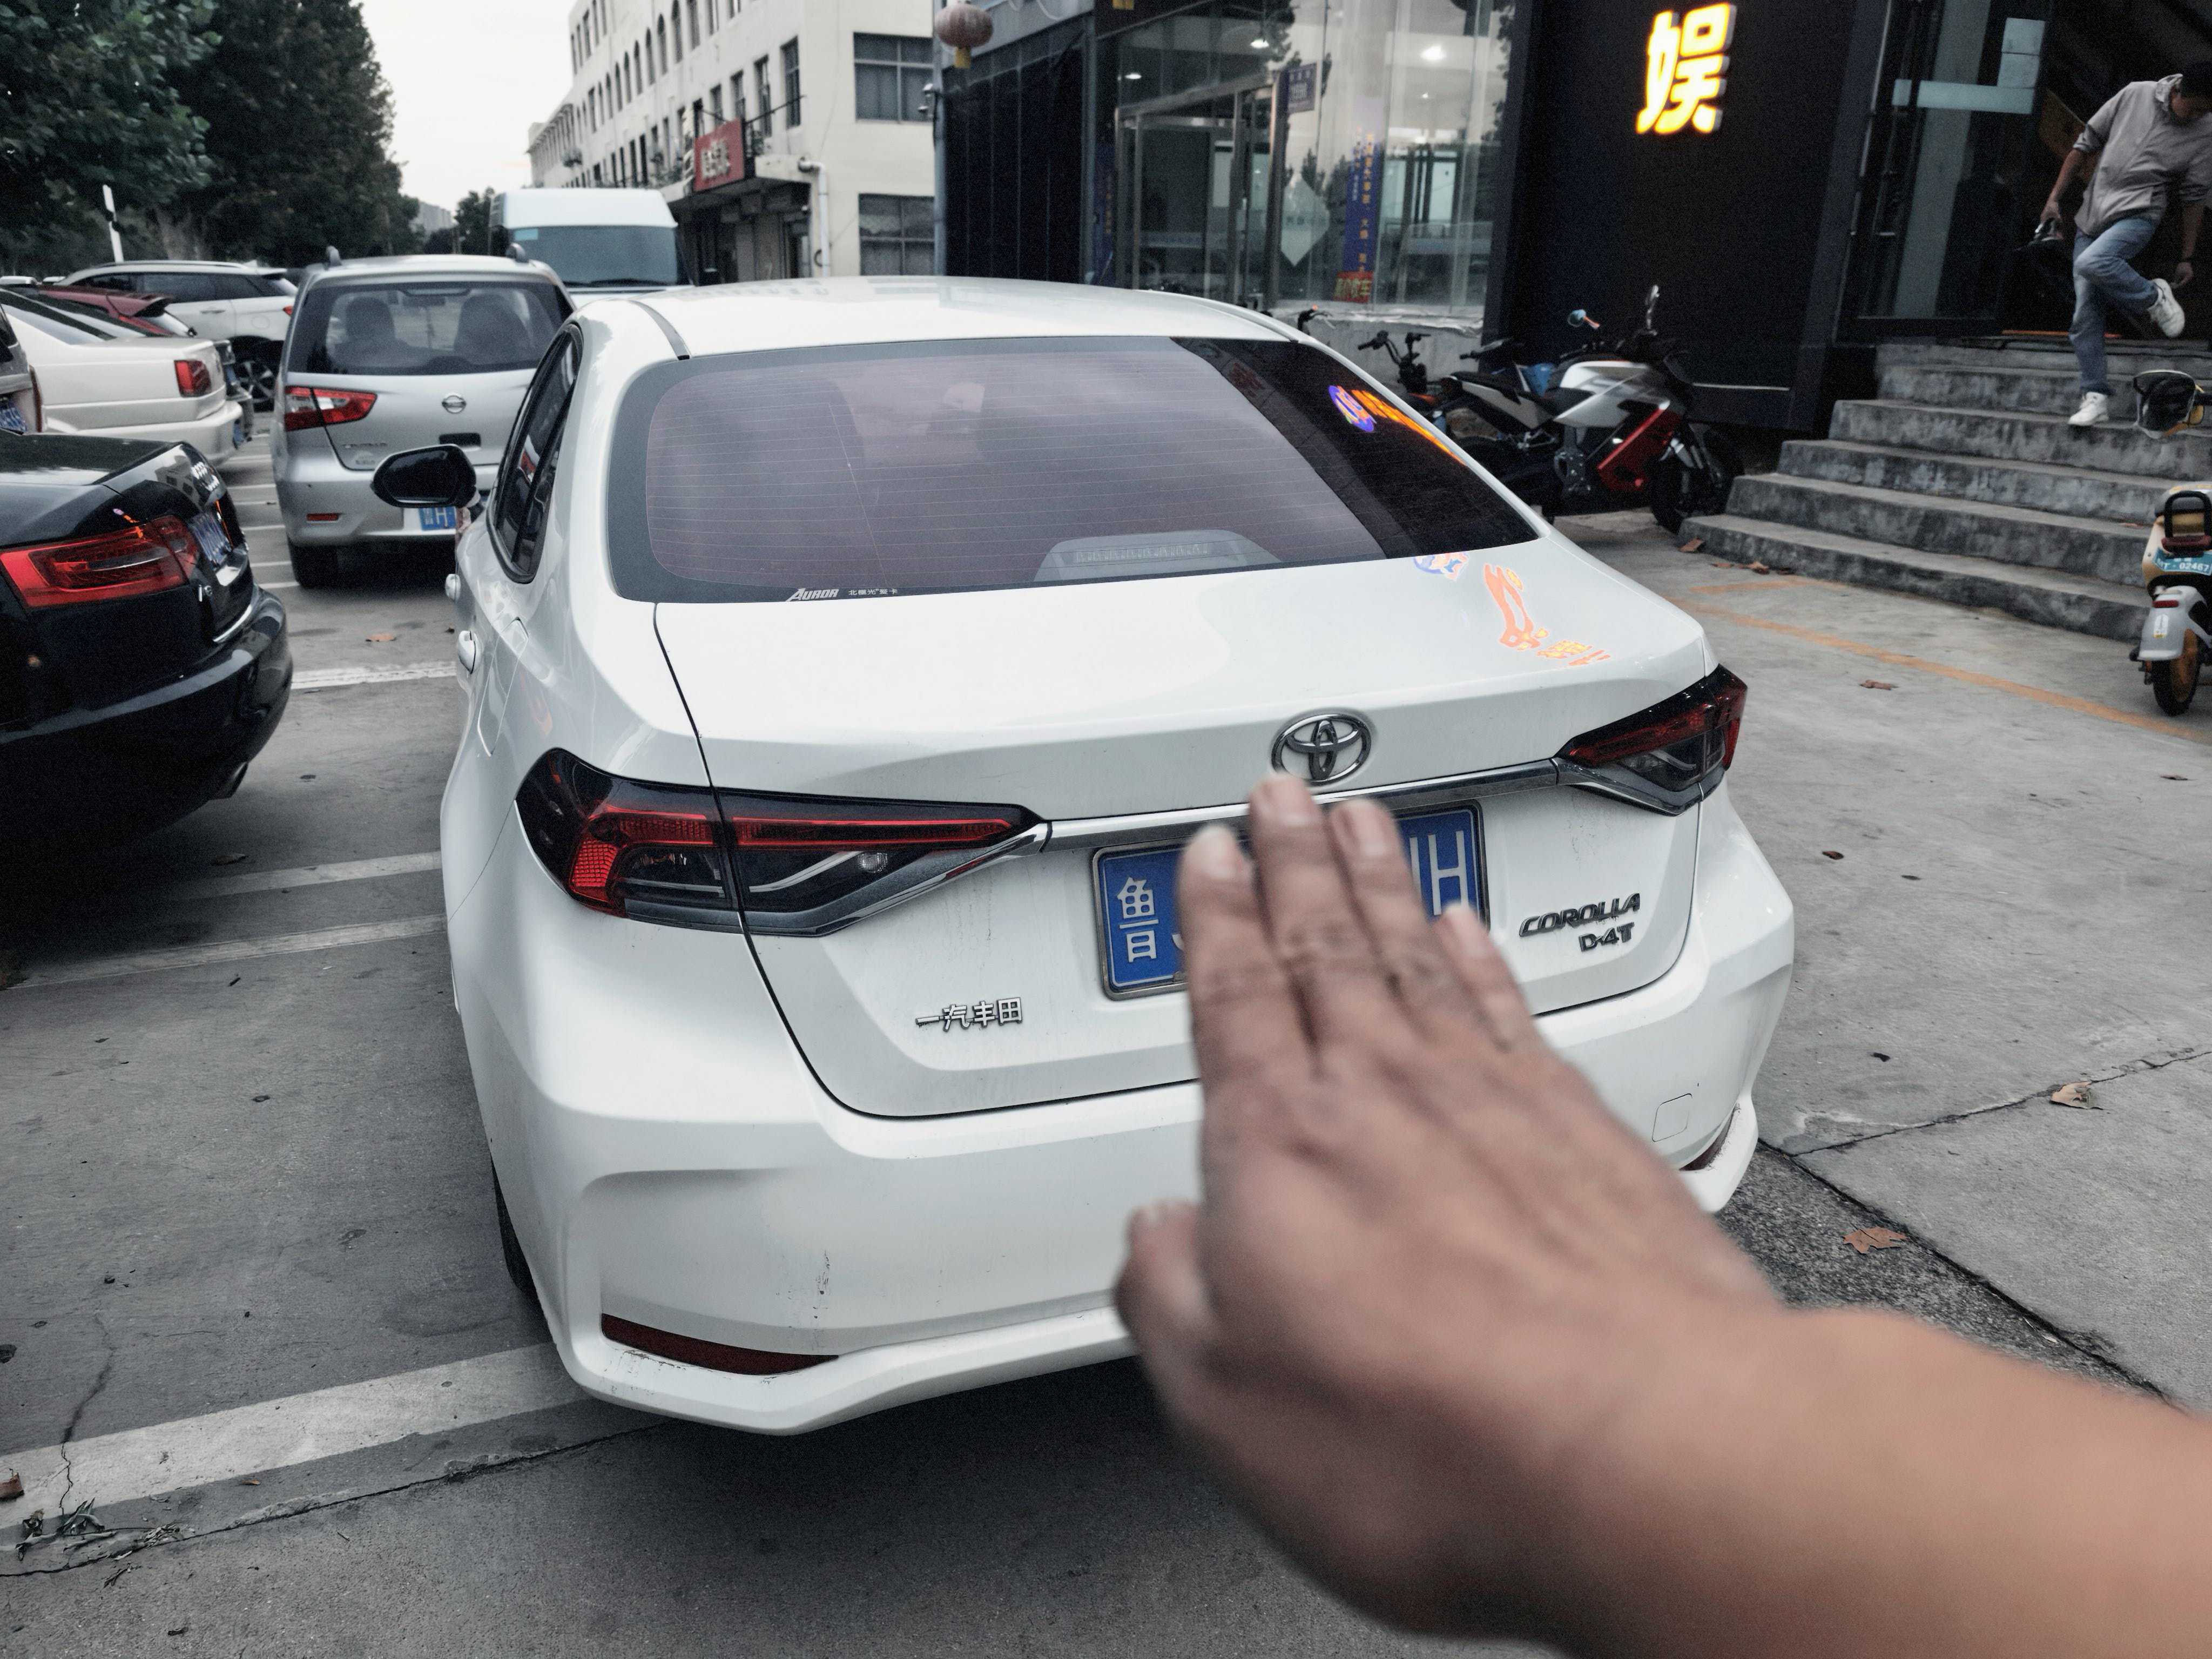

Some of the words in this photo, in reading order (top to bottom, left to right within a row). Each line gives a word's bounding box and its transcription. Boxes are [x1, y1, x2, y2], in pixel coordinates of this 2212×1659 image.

[1635, 3, 1732, 134] 娱
[1519, 893, 1641, 938] COROLLA
[915, 996, 1023, 1033] 一汽丰田
